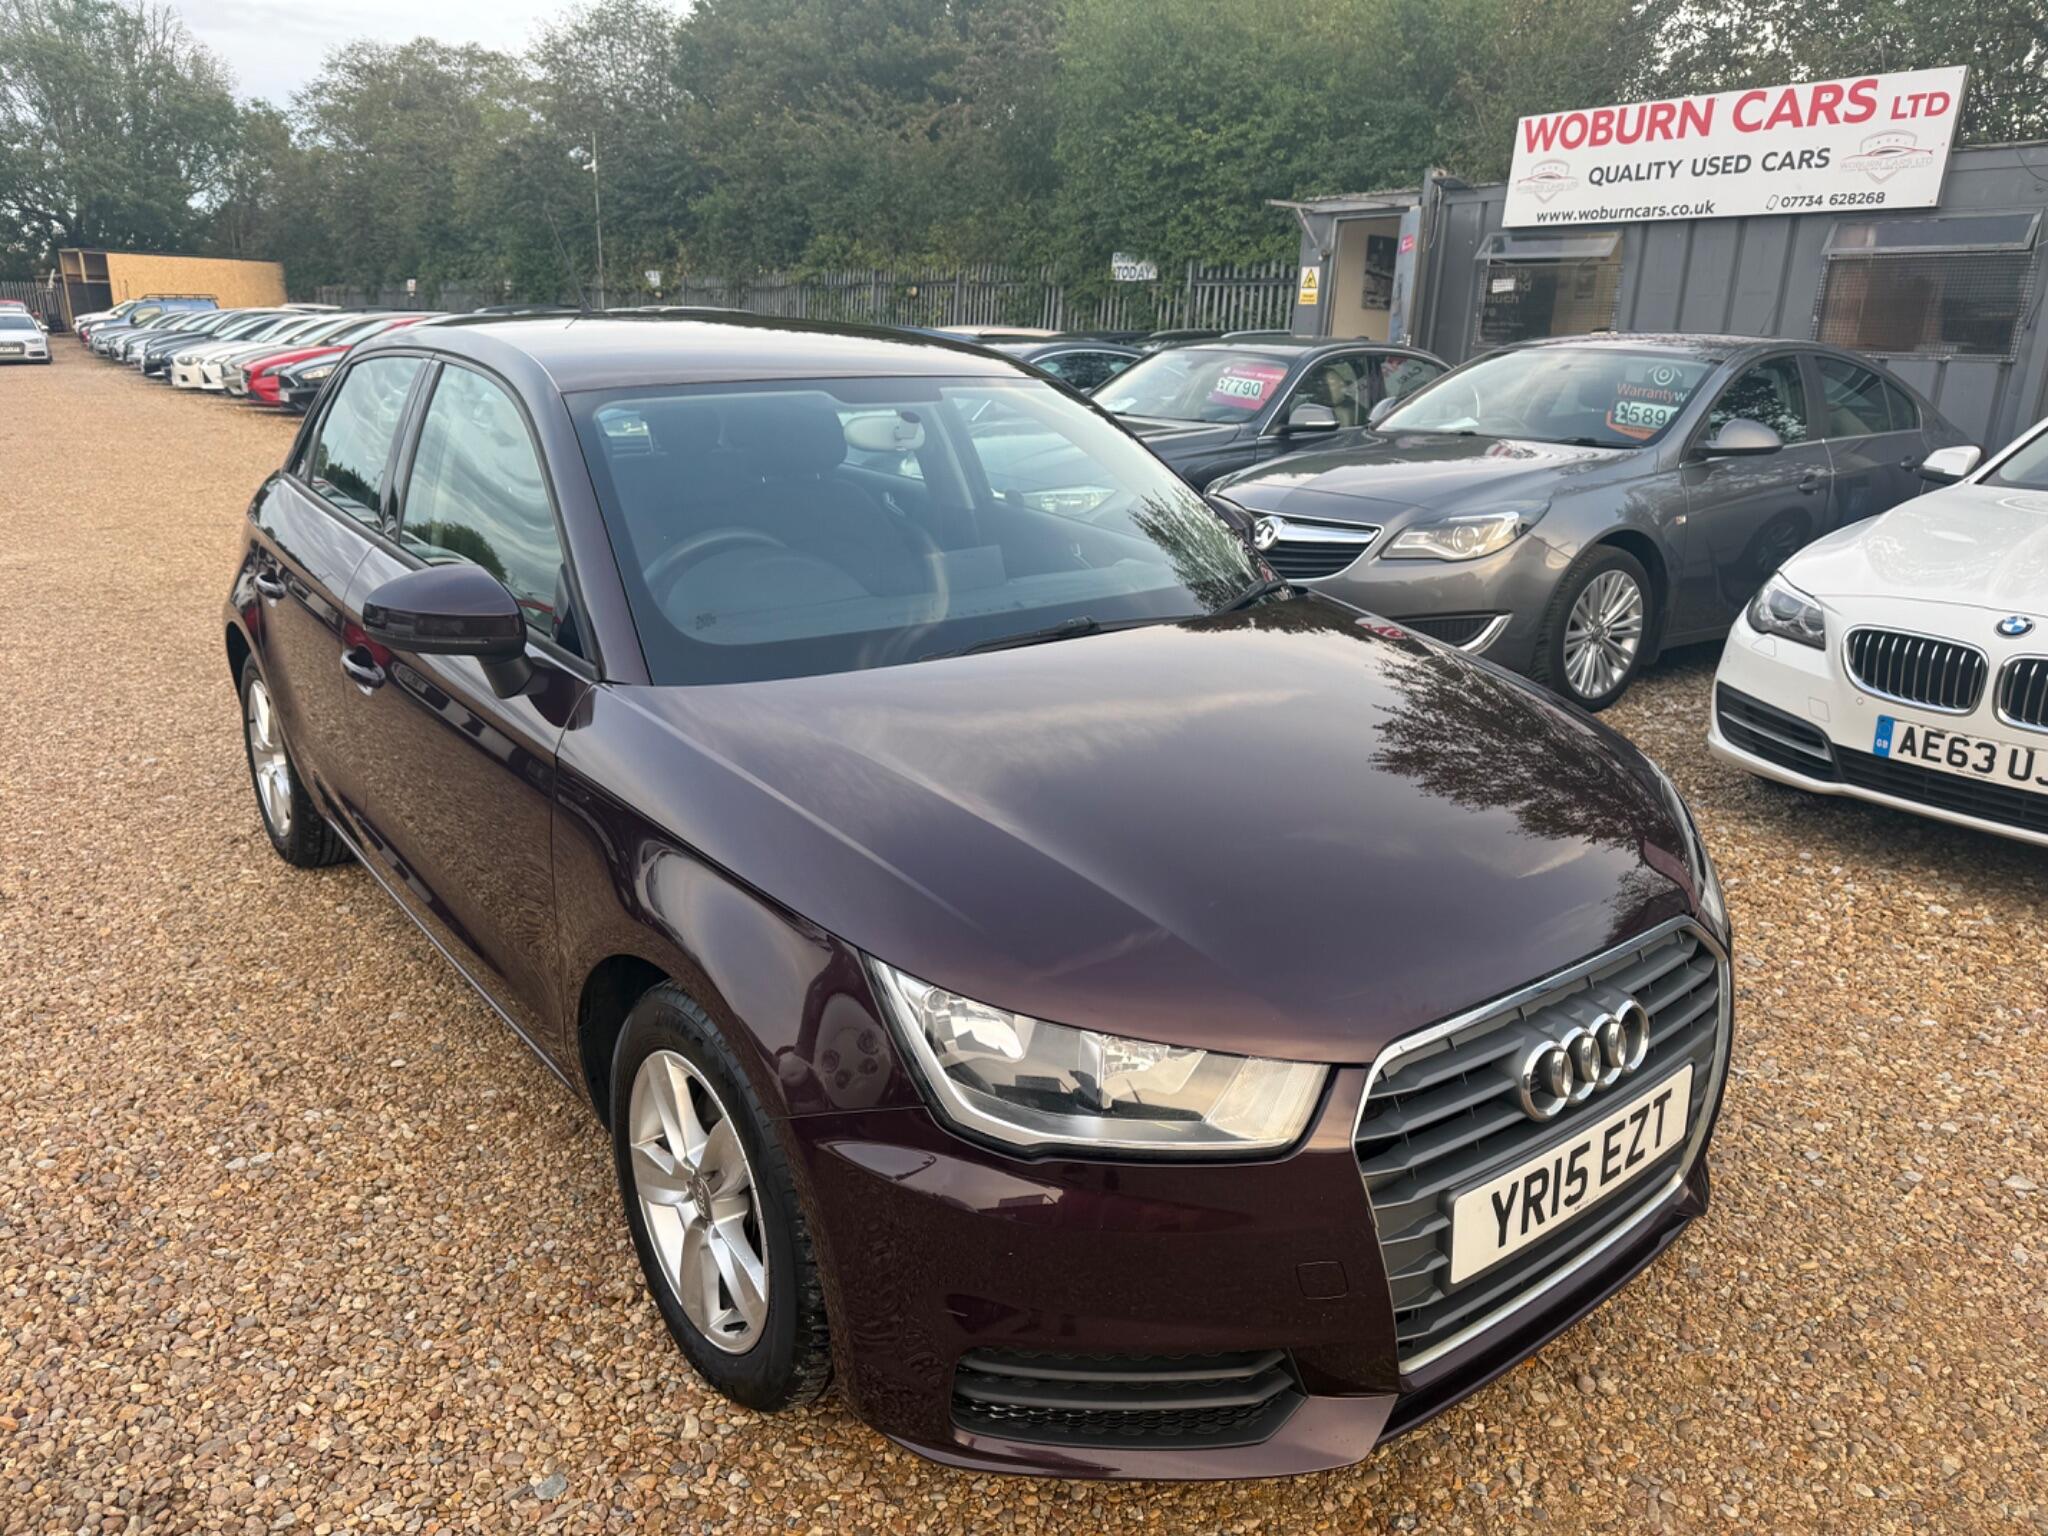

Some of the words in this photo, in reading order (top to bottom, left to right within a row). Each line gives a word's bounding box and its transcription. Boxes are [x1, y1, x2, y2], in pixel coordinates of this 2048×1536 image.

[1524, 97, 1716, 153] WOBURN
[1732, 79, 1878, 133] CARS
[1891, 91, 1951, 120] LTD
[1589, 158, 1683, 186] QUALITY
[1691, 154, 1752, 176] USED
[1761, 147, 1831, 172] CARS
[1536, 199, 1715, 223] www.woburncars.co.uk
[1781, 195, 1823, 208] 07734
[1829, 191, 1885, 206] 628268
[1617, 384, 1691, 403] Warrantyw
[1898, 726, 1996, 774] AE63
[1491, 1141, 1591, 1248] YR15
[1600, 1087, 1672, 1186] EZT
